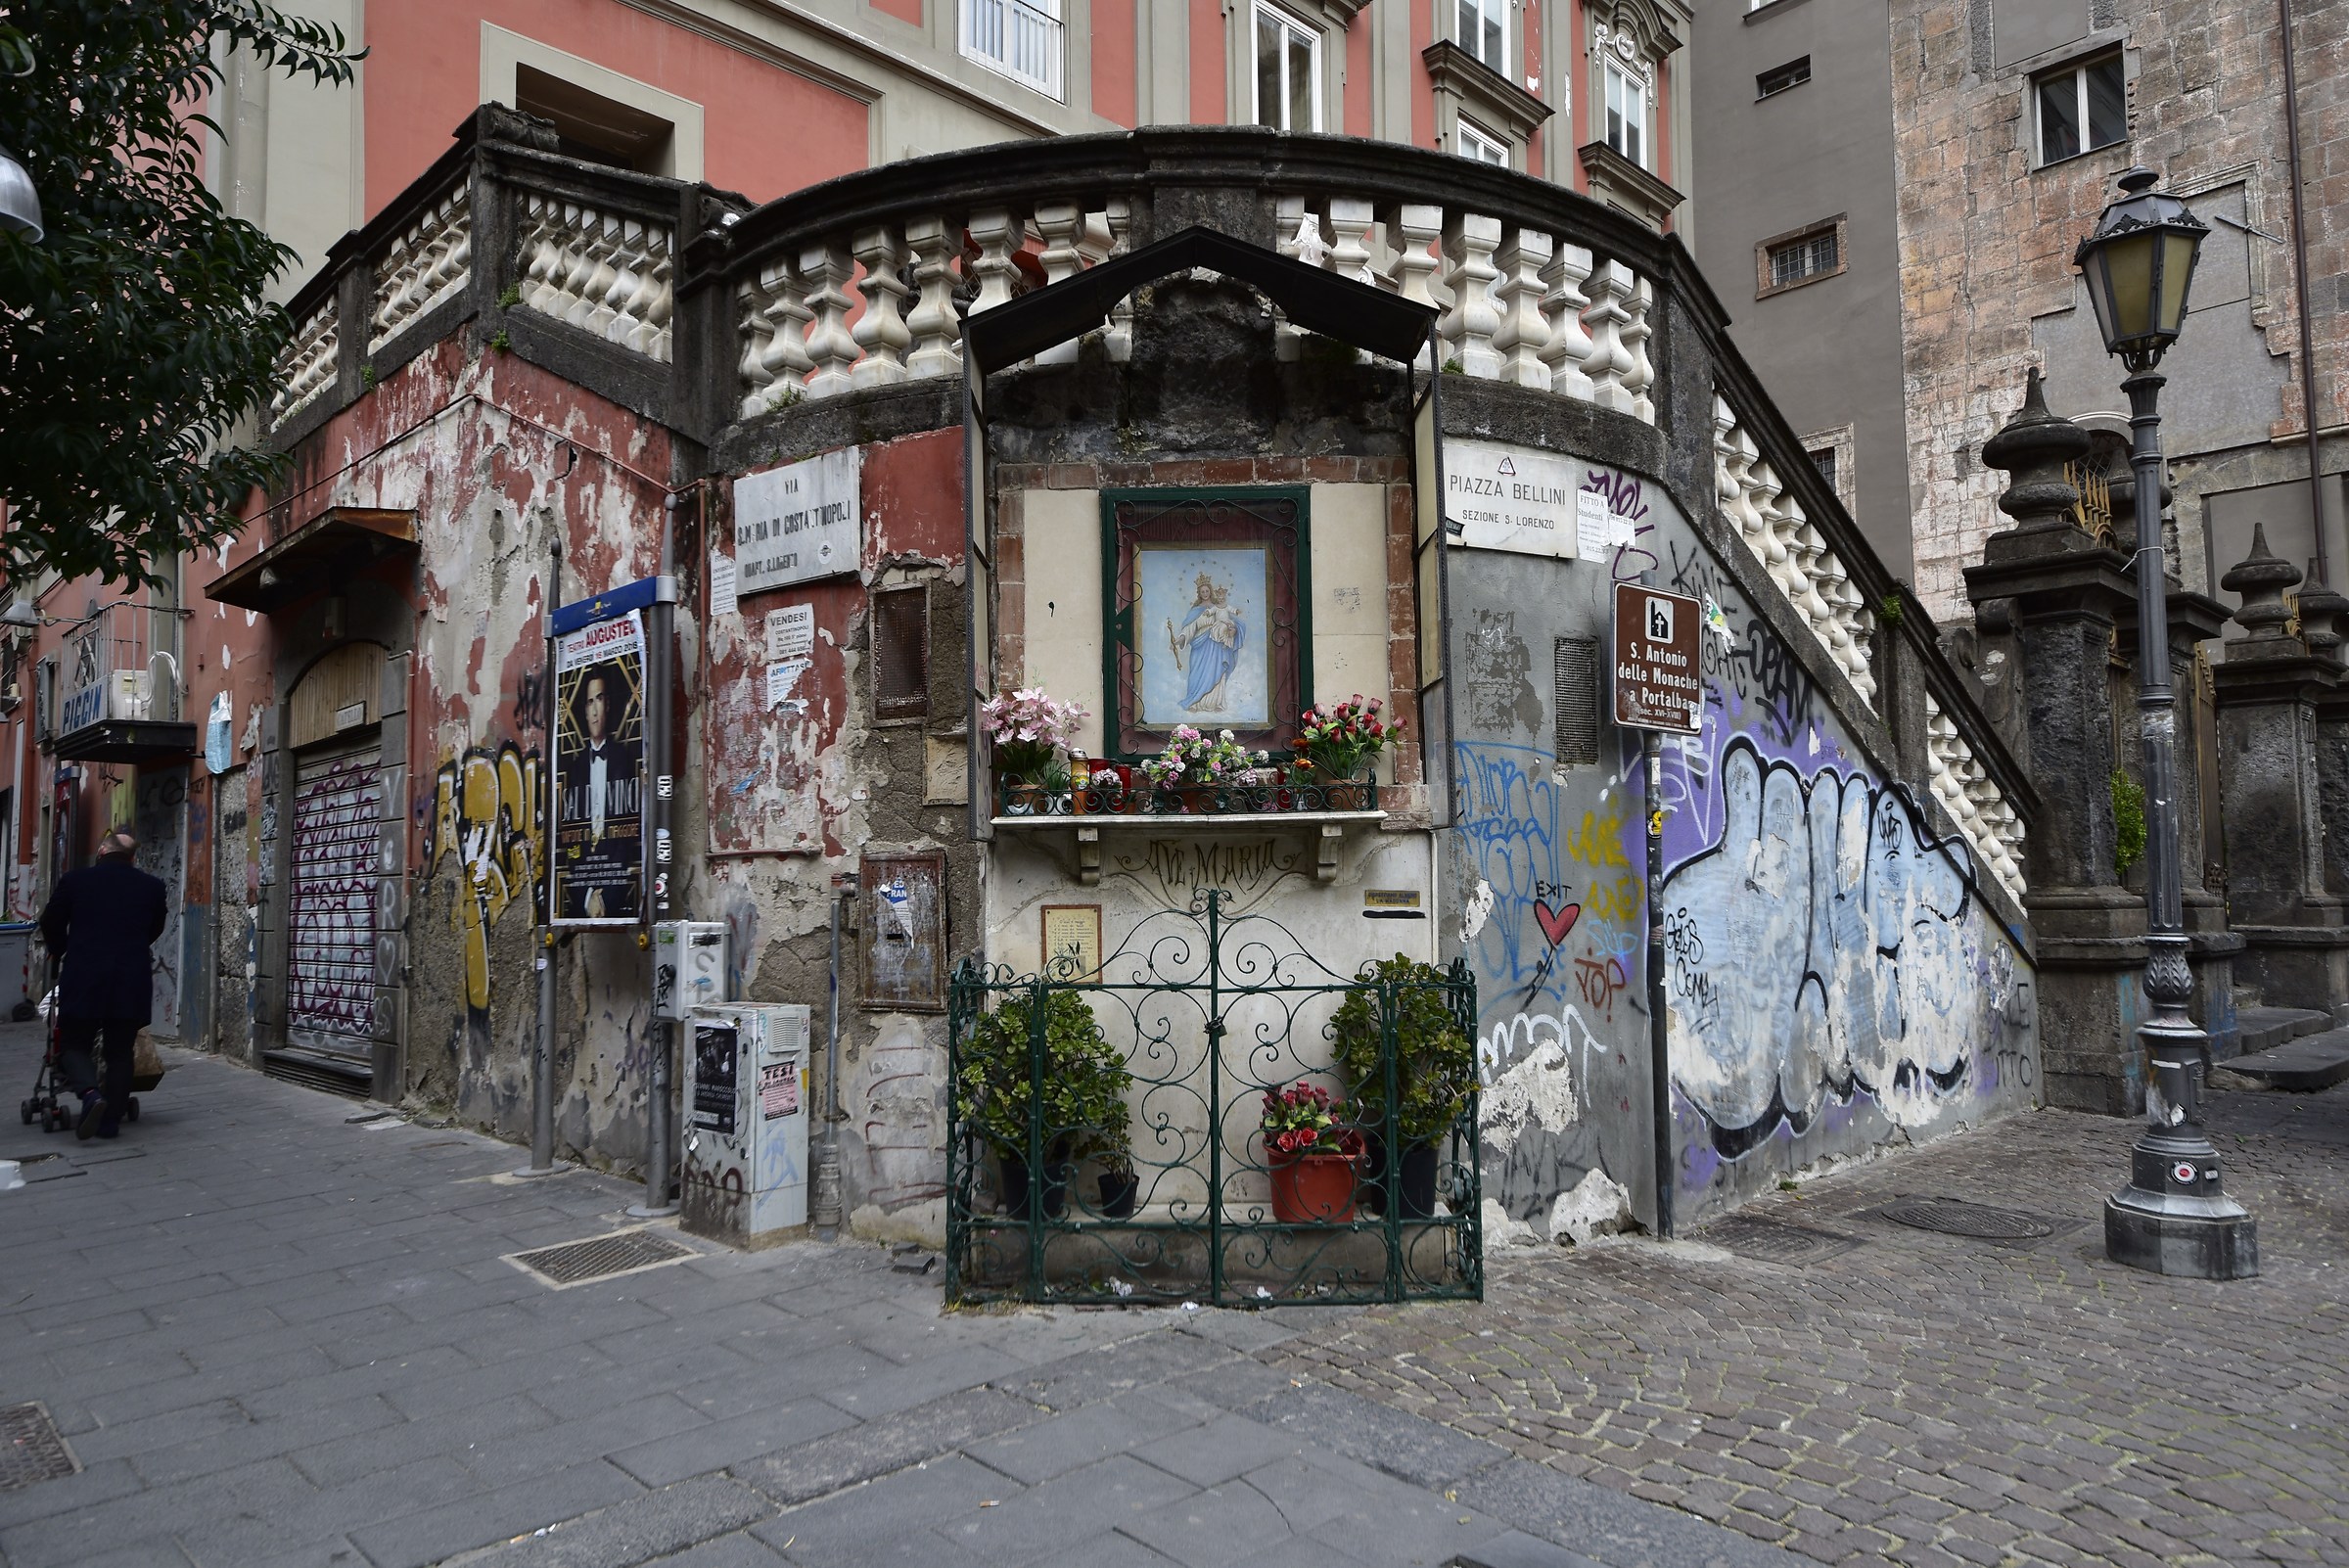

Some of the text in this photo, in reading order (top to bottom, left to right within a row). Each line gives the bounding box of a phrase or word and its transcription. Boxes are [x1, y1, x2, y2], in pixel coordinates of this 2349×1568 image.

[785, 478, 799, 494] VIA
[1450, 475, 1566, 506] PIAZZA BELLINI
[1462, 509, 1555, 530] SEZIONE S. LORENZO
[1578, 508, 1603, 522] Studenti
[737, 521, 768, 546] S.MRIA
[772, 517, 780, 537] DI
[770, 612, 807, 627] VENDESI
[1631, 641, 1687, 668] S. Antonio
[1618, 662, 1698, 690] delle Monache
[1630, 686, 1689, 710] a Portalba
[562, 785, 581, 821] SAL
[1145, 839, 1275, 895] AVE MARIA
[1537, 880, 1572, 899] EXIT
[763, 1064, 794, 1080] TESI
